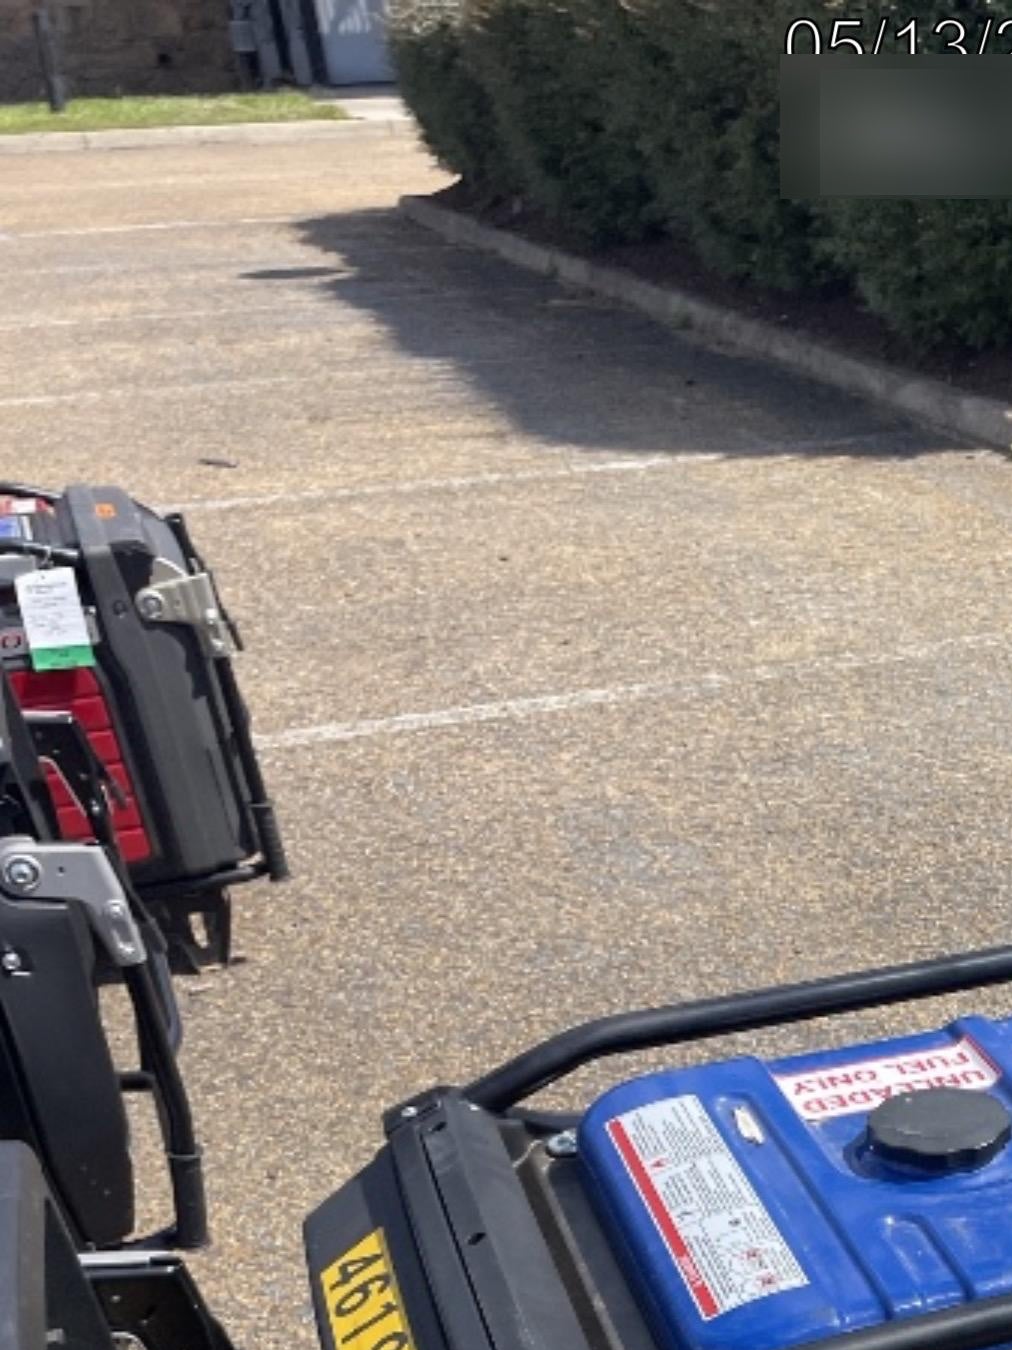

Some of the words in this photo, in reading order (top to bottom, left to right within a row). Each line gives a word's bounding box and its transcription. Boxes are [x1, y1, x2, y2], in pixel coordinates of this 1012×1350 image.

[883, 1051, 970, 1075] FUEL
[794, 1070, 878, 1096] ONLY
[803, 1070, 986, 1113] UNLEADED
